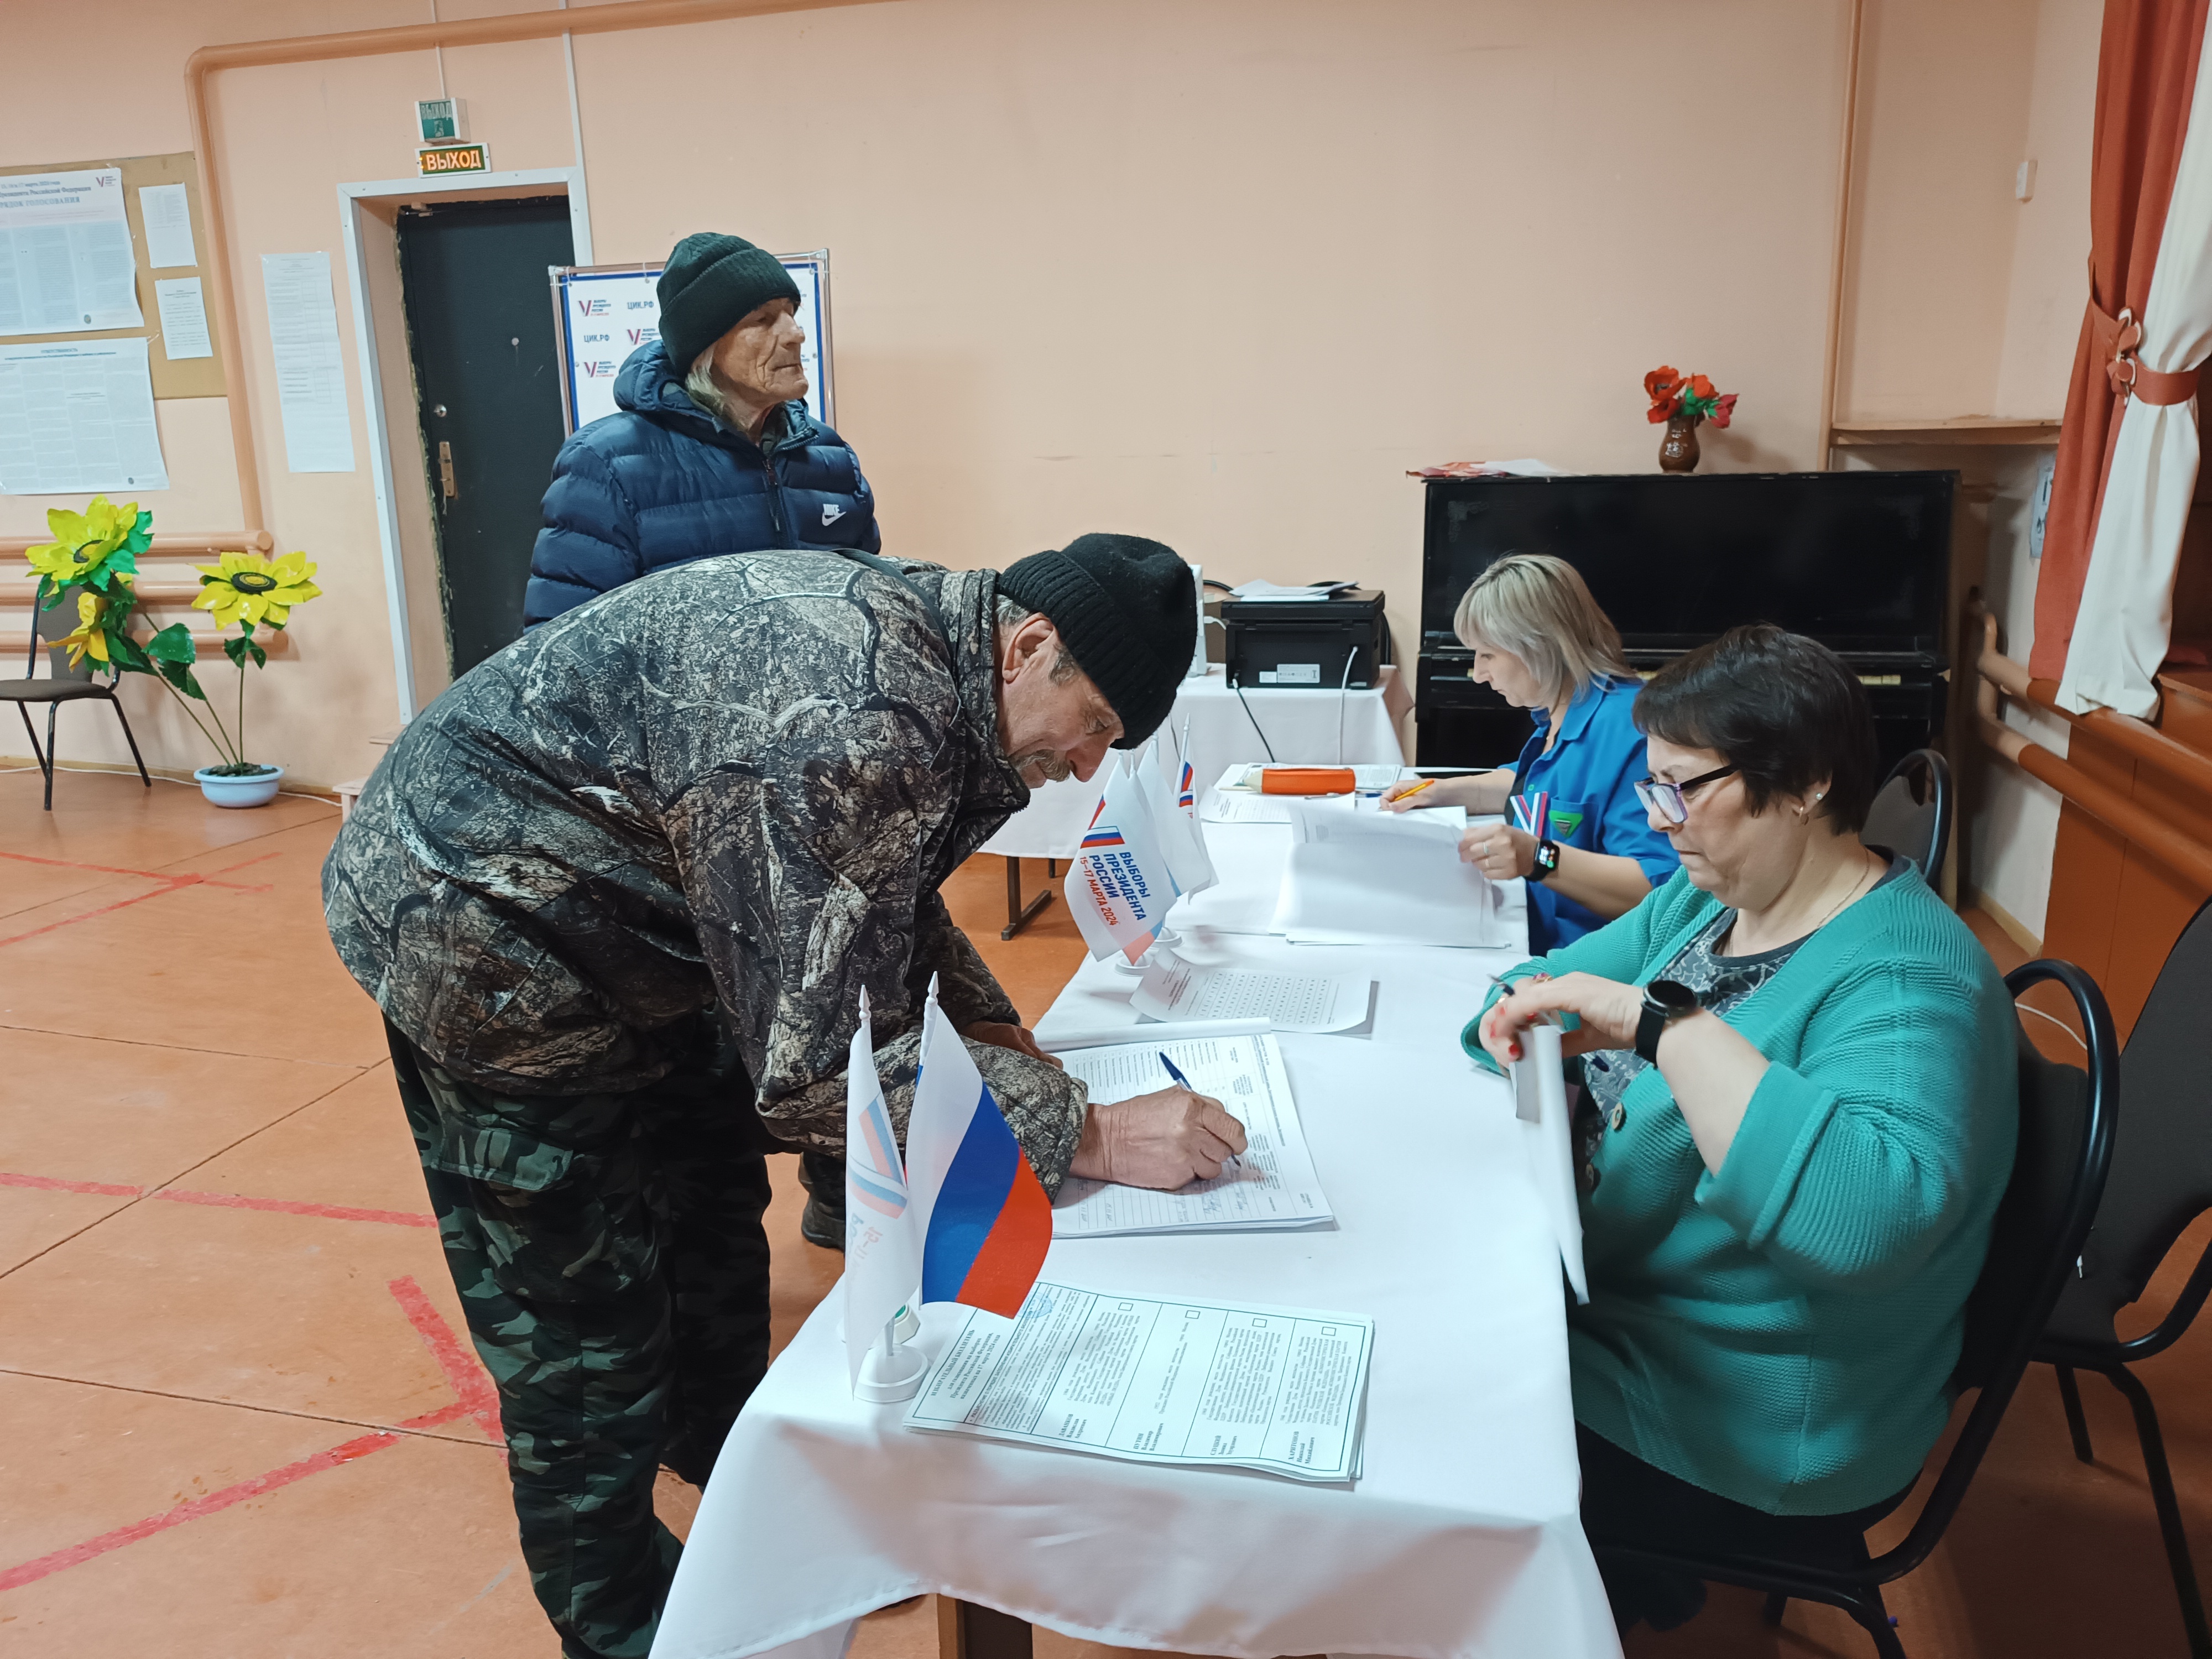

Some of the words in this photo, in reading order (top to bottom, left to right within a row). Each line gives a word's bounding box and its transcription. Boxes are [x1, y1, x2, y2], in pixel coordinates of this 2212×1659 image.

[426, 150, 481, 170] ВЫХОД
[26, 196, 80, 206] ГОЛОСОВАНИЯ
[627, 301, 654, 310] ЦИК.РФ
[583, 335, 610, 343] ЦИК.РФ
[823, 503, 840, 515] NIKE
[1089, 854, 1120, 899] РОССИИ
[1119, 852, 1150, 899] ВЫБОРЫ
[1103, 853, 1147, 921] ПРЕЗИДЕНТА
[1087, 879, 1105, 906] МАРТА
[1102, 906, 1119, 926] 2024
[967, 1337, 983, 1354] выборах
[979, 1352, 992, 1364] марта
[986, 1343, 996, 1352] 2024
[992, 1334, 1001, 1343] года
[930, 1357, 959, 1396] ИЗБИРАТЕЛЬНЫЙ
[953, 1329, 976, 1357] БЮЛЛЕТЕНЬ
[949, 1376, 968, 1399] Президента
[963, 1355, 981, 1376] Российской
[1057, 1413, 1073, 1437] ДАВАНКОВ
[1132, 1433, 1144, 1449] ПУТИН
[1140, 1430, 1154, 1450] Владимир
[1287, 1431, 1300, 1460] ХАРИТОНОВ
[1296, 1442, 1305, 1462] Николай
